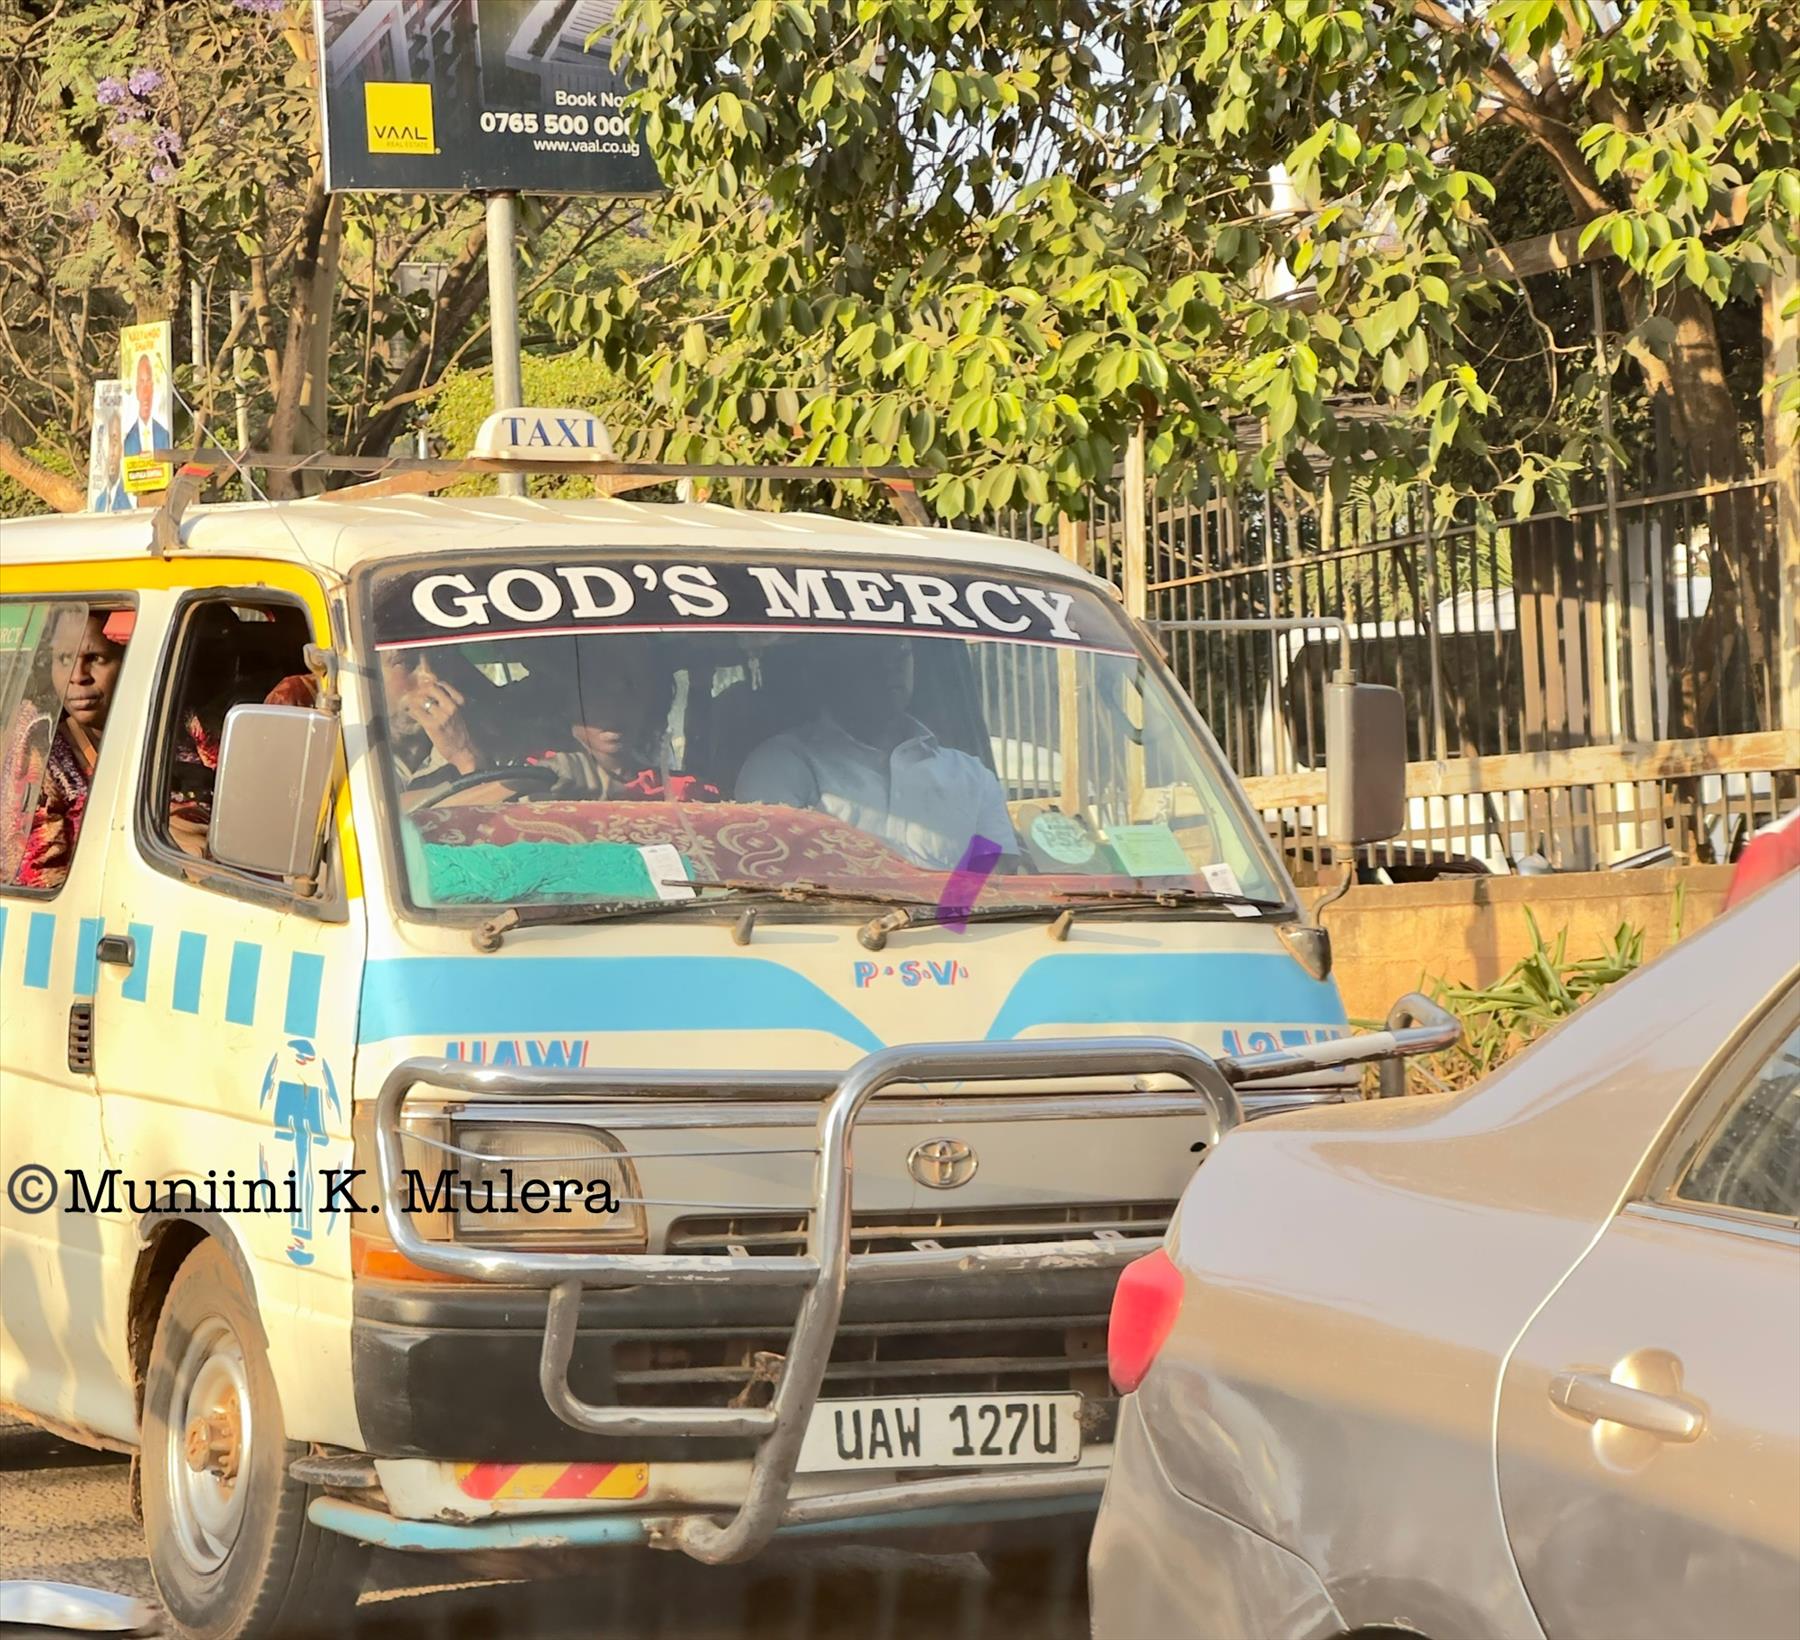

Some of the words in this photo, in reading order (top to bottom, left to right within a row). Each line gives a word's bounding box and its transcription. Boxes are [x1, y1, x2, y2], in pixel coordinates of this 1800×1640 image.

[555, 90, 597, 107] Book
[374, 126, 428, 140] VAAL
[480, 112, 539, 135] 0765
[544, 114, 589, 136] 500
[533, 139, 640, 157] www.vaal.co.ug
[501, 417, 596, 447] TAXI
[411, 564, 730, 629] GOD'S
[747, 566, 1082, 641] MERCY
[835, 1407, 921, 1460] UAW
[949, 1403, 1057, 1456] 127U
